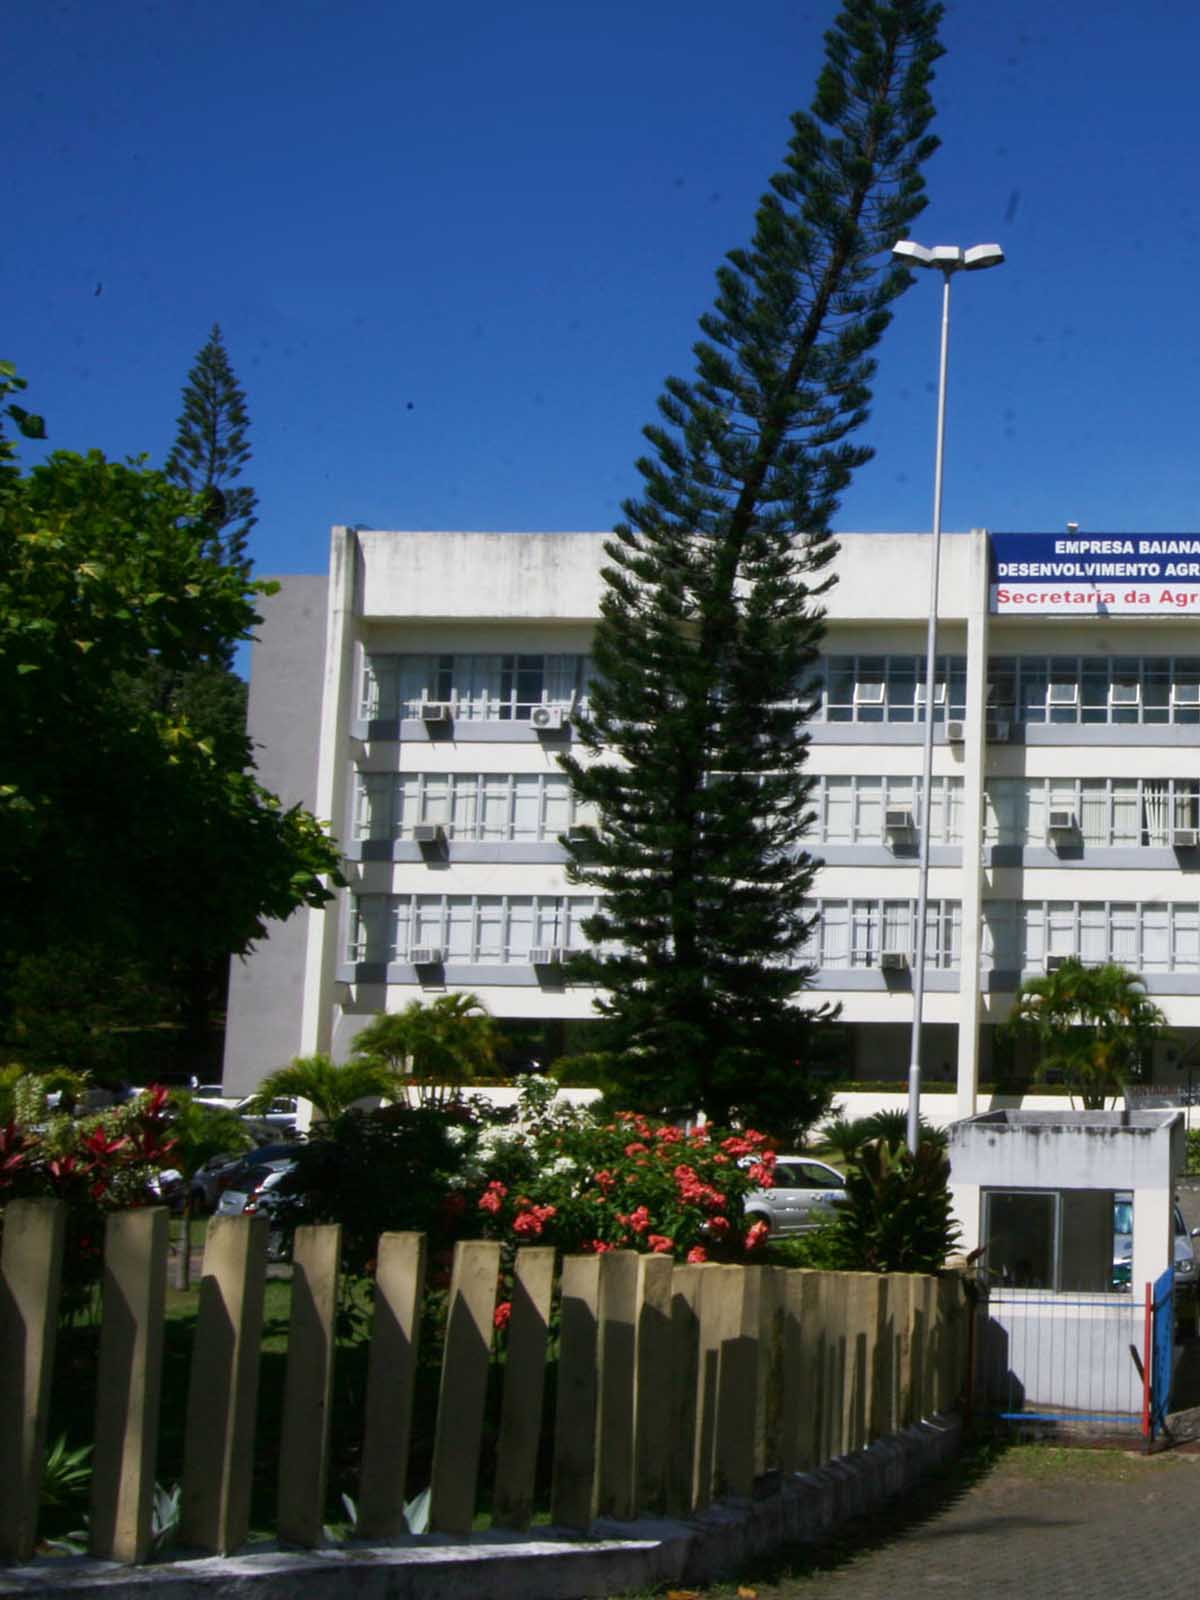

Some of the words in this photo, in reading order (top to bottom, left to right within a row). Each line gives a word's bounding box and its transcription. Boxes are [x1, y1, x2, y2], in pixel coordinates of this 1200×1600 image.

[1055, 540, 1134, 554] EMPRESA
[998, 563, 1160, 577] DESENVOLVIMENTO
[997, 589, 1115, 604] Secretaria
[1123, 589, 1150, 604] da
